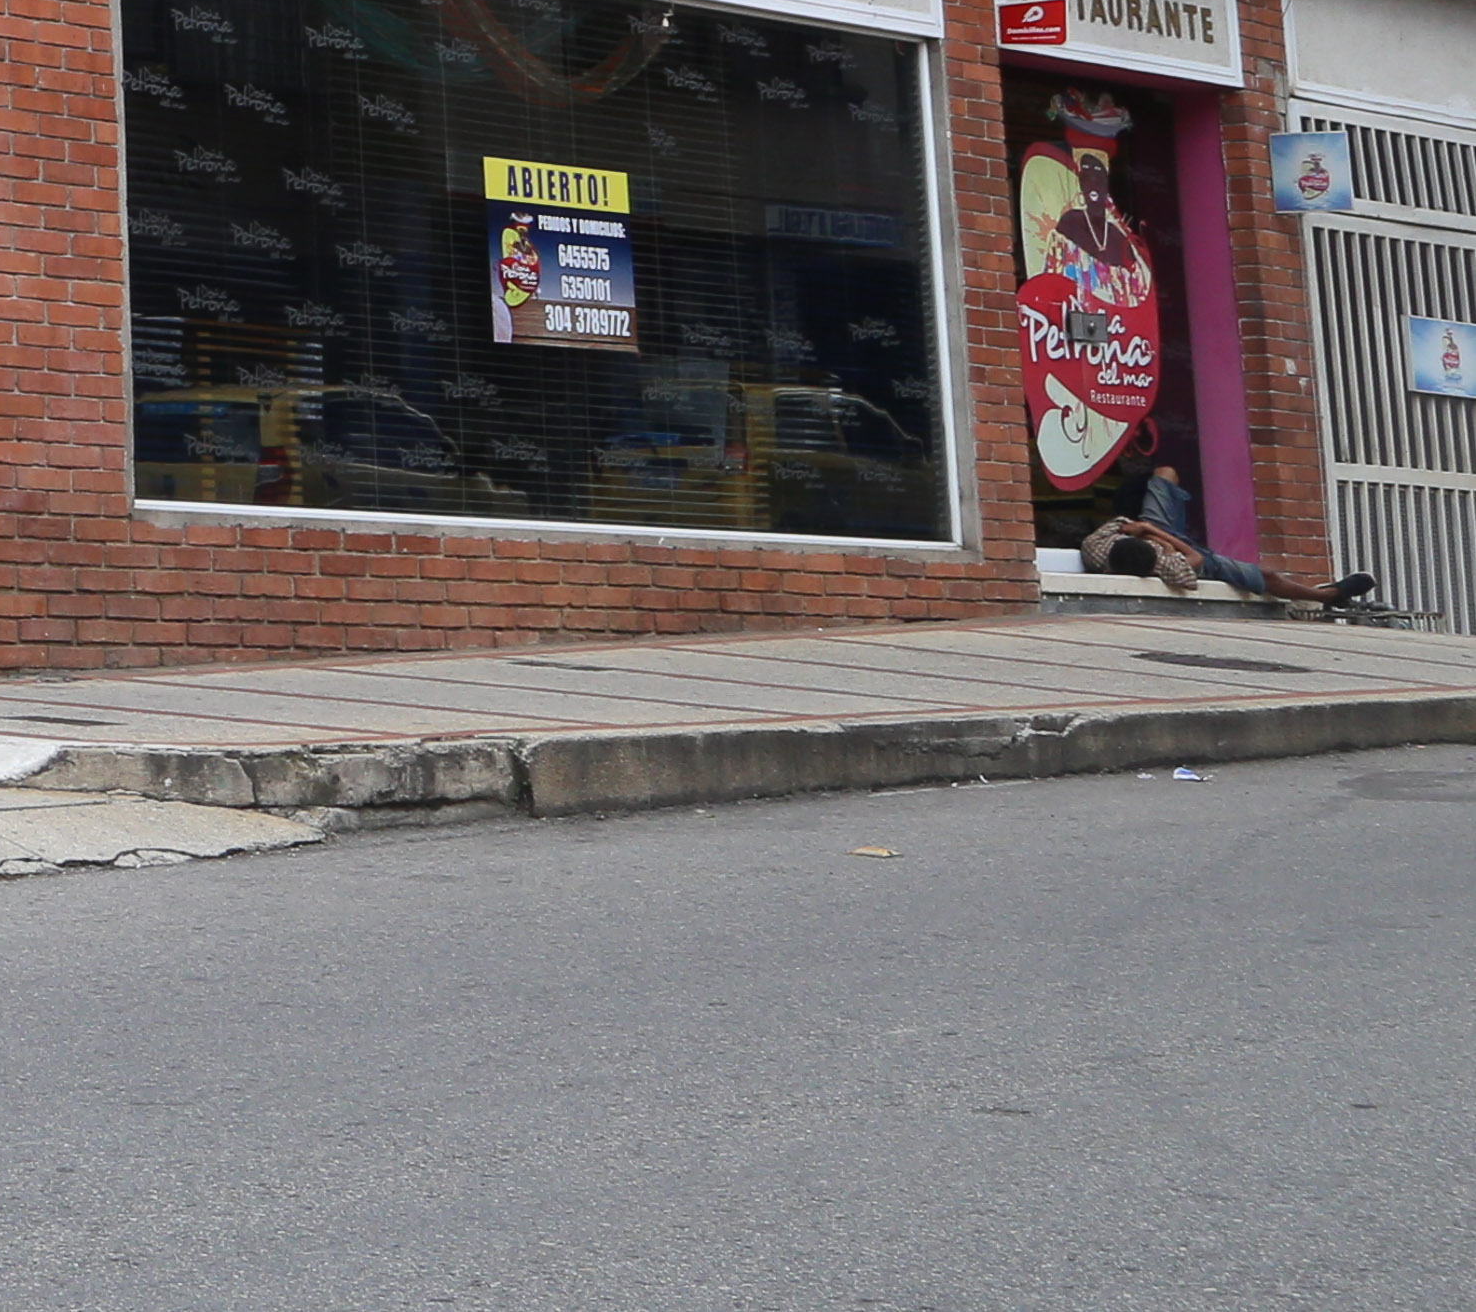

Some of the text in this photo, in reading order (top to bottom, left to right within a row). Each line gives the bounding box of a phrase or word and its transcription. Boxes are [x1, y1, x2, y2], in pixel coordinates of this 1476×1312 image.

[507, 165, 609, 206] ABIERTO!
[538, 215, 571, 233] PEDIDOS
[572, 219, 579, 234] Y
[558, 243, 610, 271] 6455575
[561, 275, 611, 301] 6350101
[545, 304, 631, 337] 304 3789772
[1097, 360, 1154, 387] del mar
[1090, 389, 1147, 407] Restaurante
